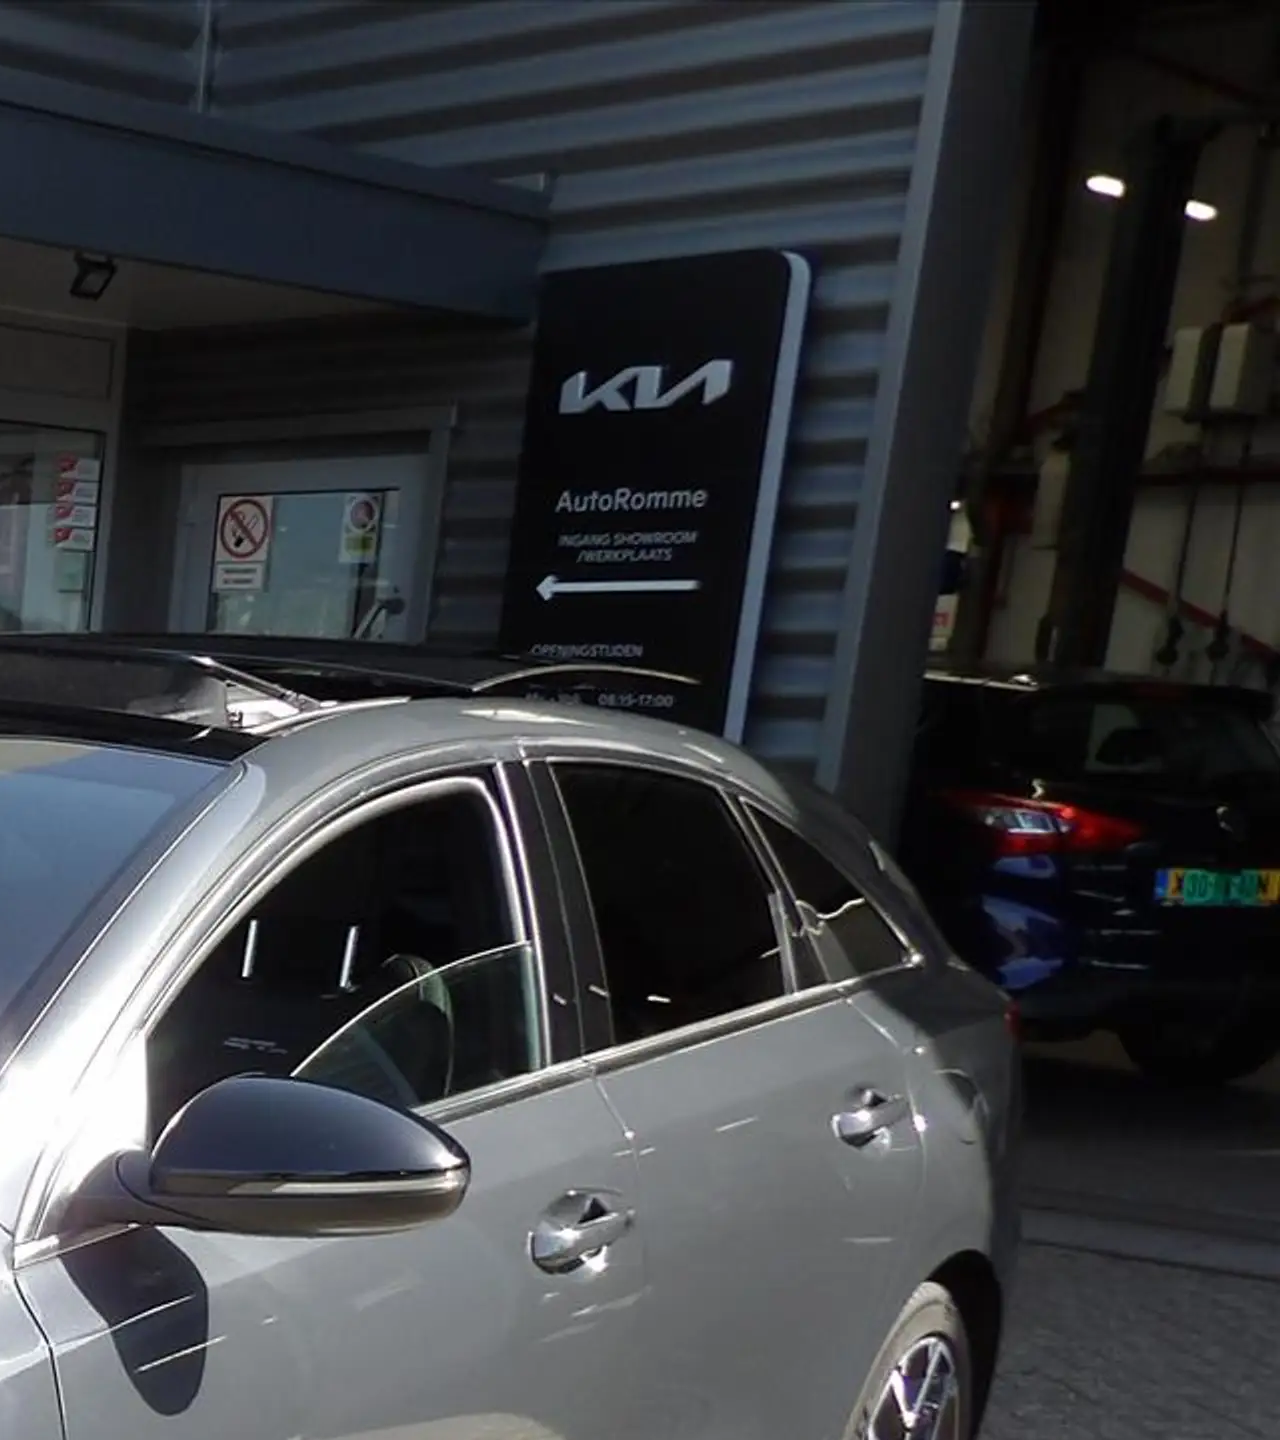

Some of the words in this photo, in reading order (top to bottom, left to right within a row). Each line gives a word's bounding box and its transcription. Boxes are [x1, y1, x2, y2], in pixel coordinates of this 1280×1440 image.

[559, 358, 734, 415] KIA
[554, 487, 709, 514] AutoRomme
[556, 531, 611, 548] INGANG
[613, 530, 699, 547] SHOWROOM
[576, 547, 674, 564] /WERKPLAATS
